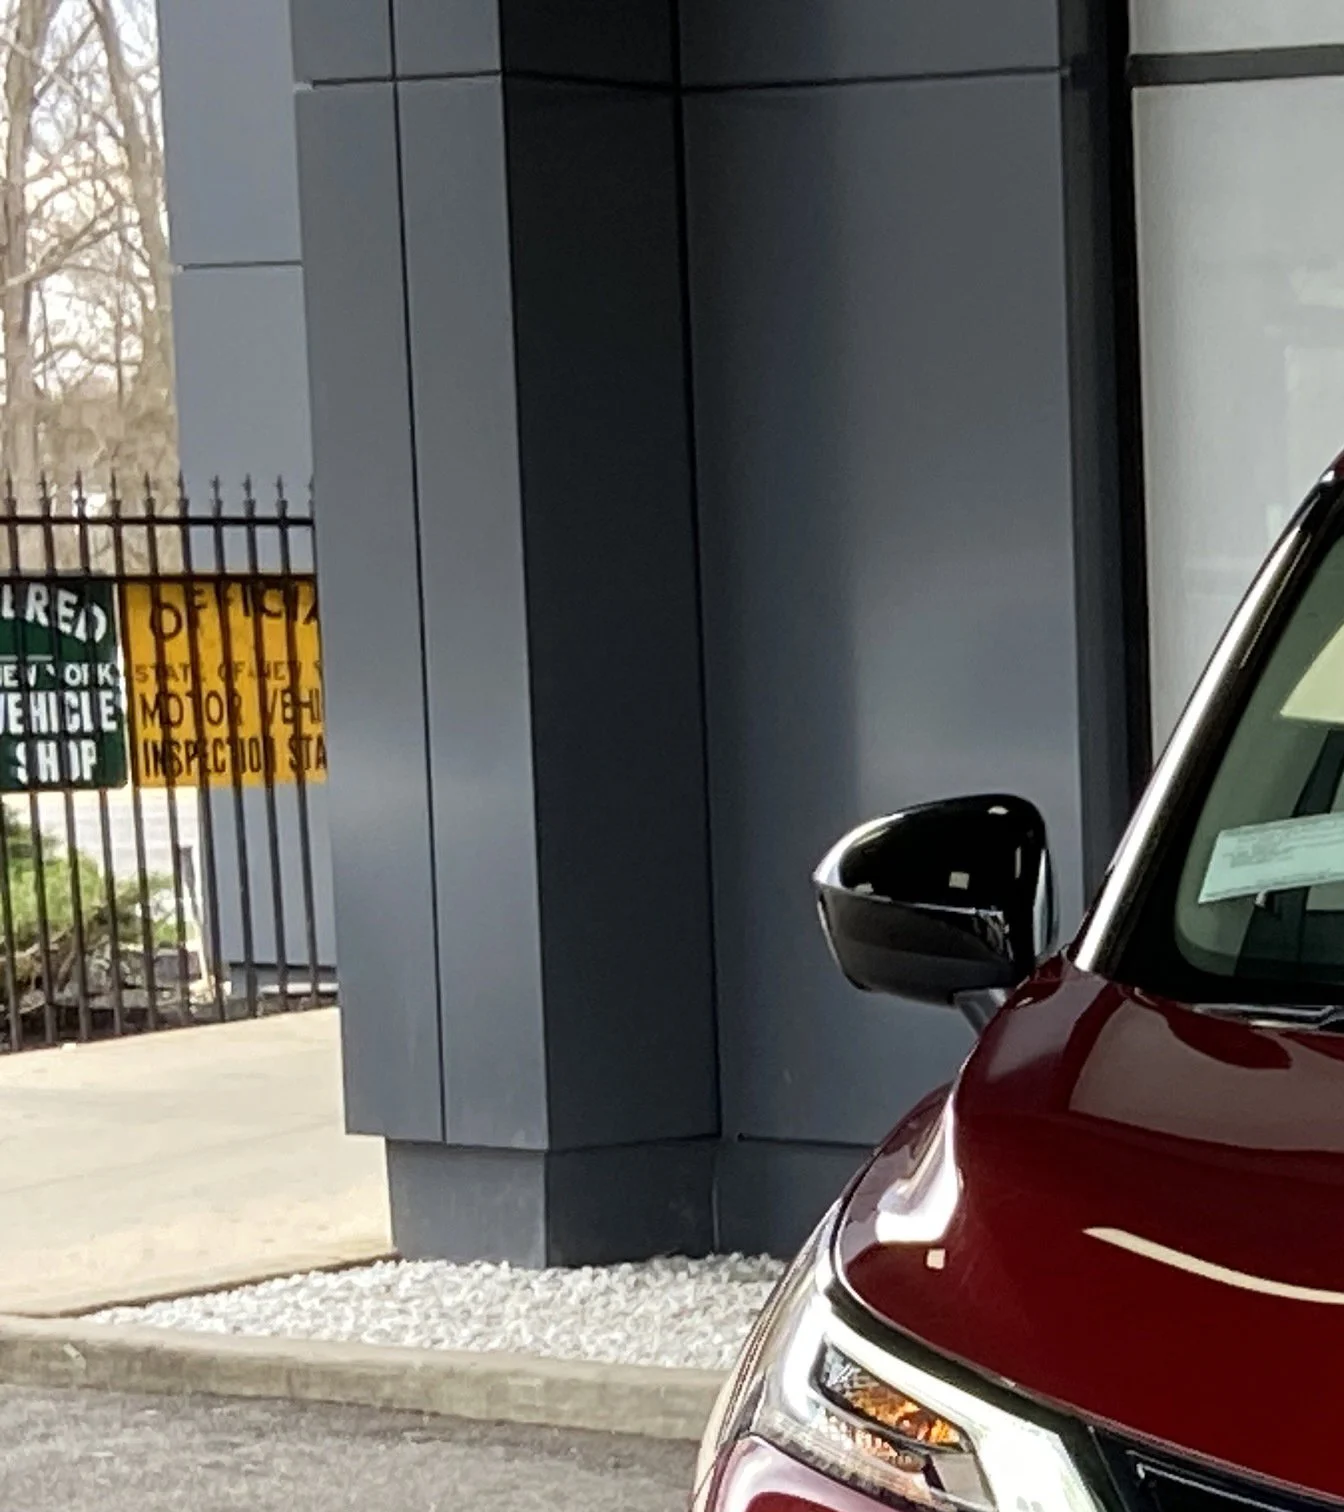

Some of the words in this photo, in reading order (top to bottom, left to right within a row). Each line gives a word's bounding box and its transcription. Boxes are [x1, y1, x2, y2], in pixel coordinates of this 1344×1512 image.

[135, 663, 206, 683] STAT
[0, 690, 117, 735] EHICLE
[143, 737, 275, 777] INSPCIO
